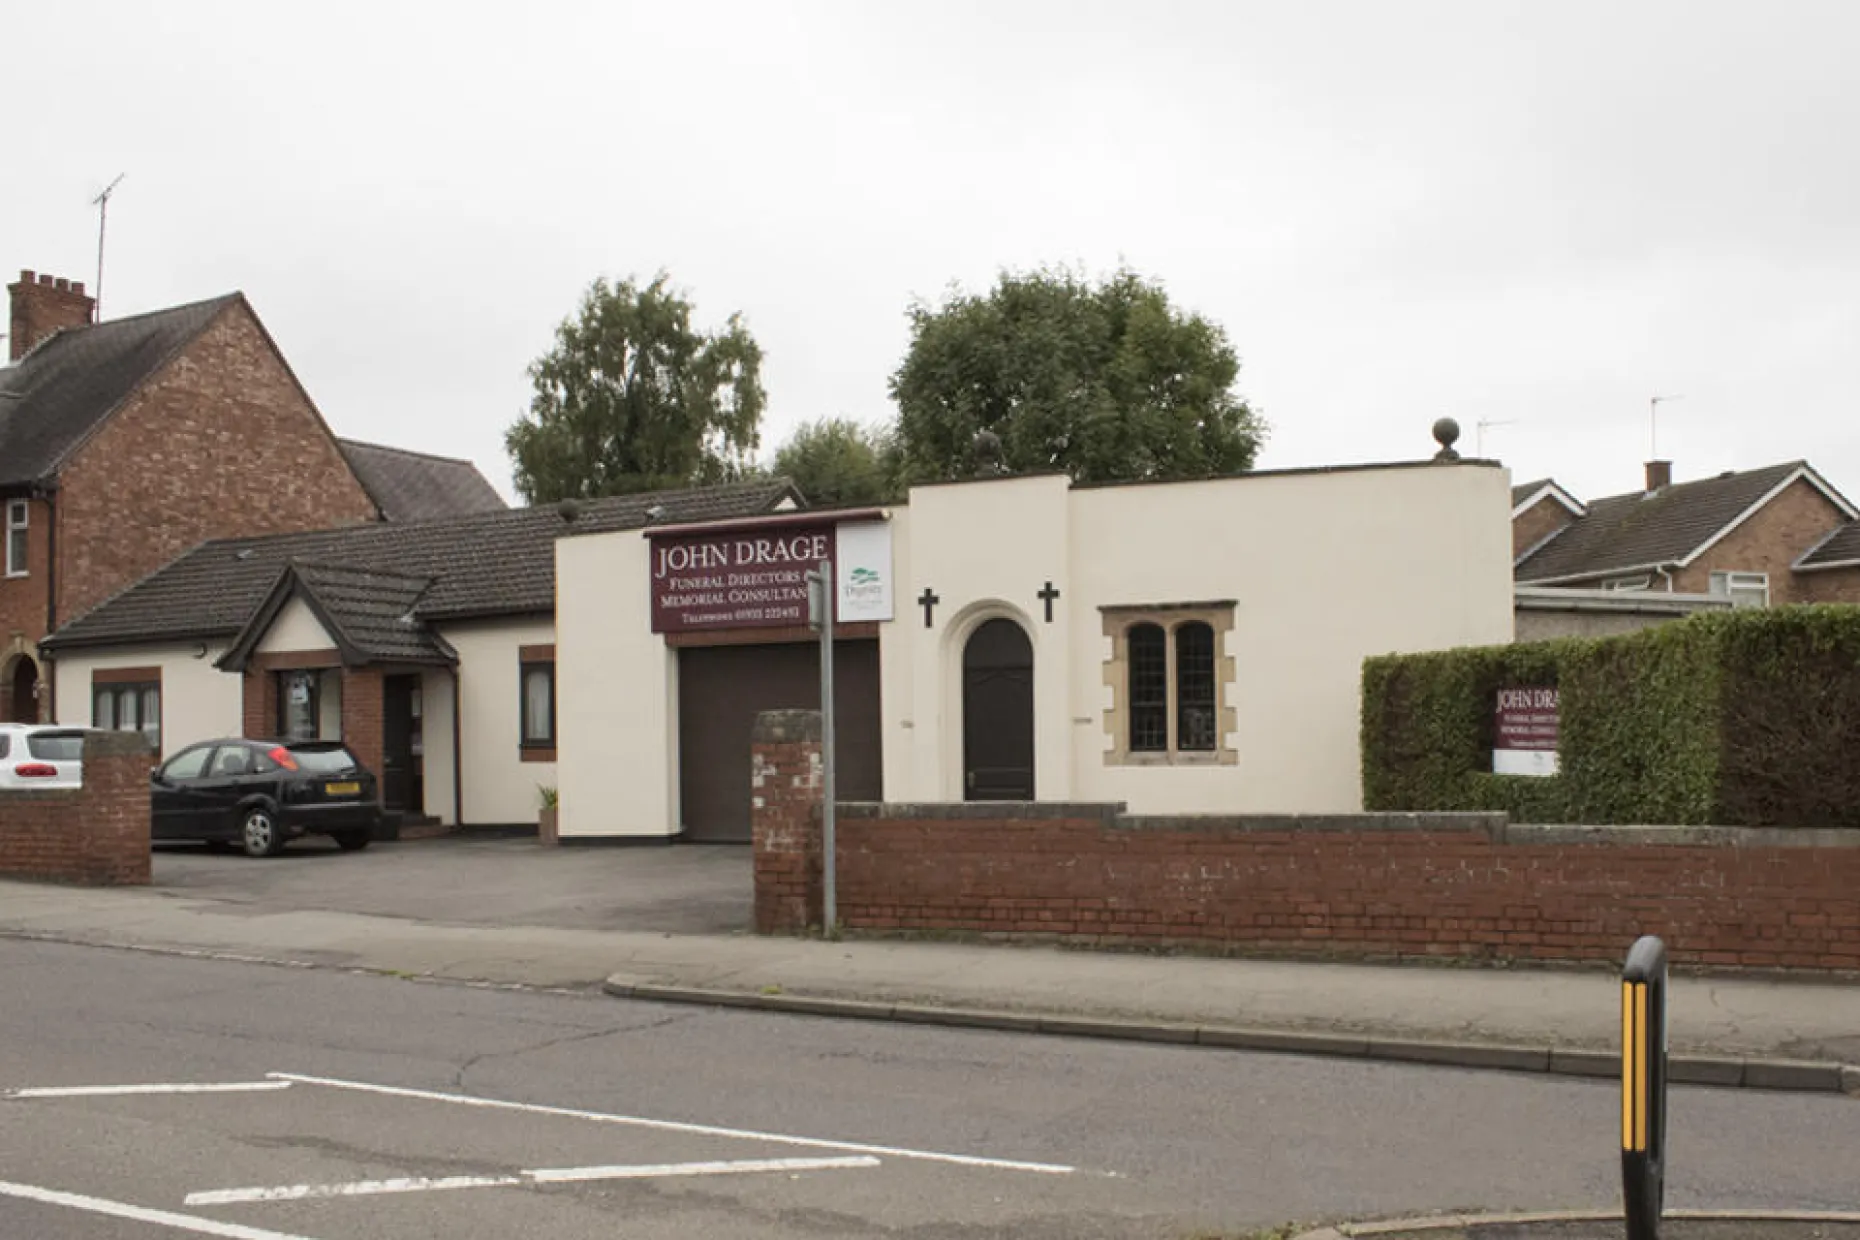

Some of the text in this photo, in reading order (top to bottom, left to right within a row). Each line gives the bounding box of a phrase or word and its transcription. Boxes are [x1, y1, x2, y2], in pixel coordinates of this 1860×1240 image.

[655, 535, 828, 578] JOHN DRAGE
[669, 576, 724, 590] FUNERAL
[728, 571, 800, 586] DIRECTORS
[661, 593, 725, 608] MEMORIAL
[1495, 690, 1531, 713] JOHN
